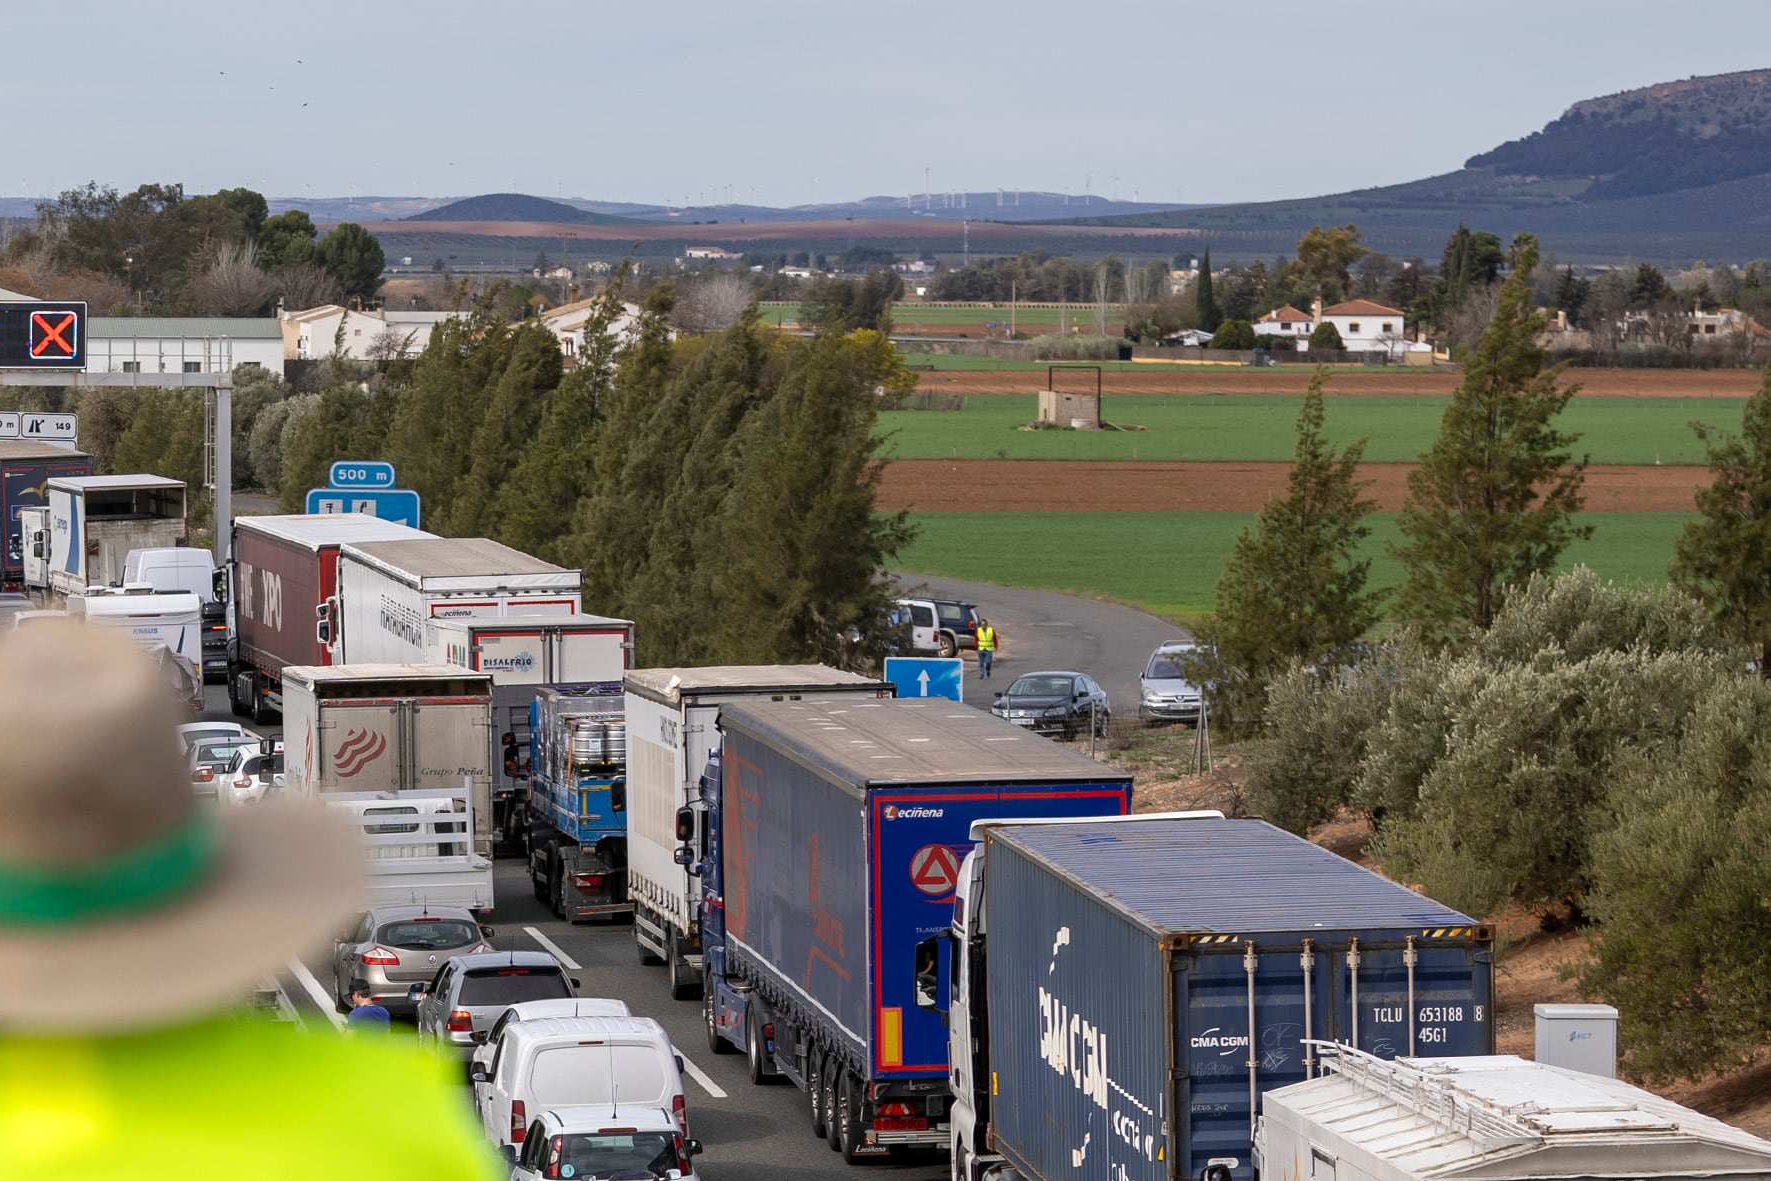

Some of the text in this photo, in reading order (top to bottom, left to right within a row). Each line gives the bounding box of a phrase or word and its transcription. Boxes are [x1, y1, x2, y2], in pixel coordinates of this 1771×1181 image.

[6, 421, 15, 429] m
[55, 422, 71, 431] 149
[338, 469, 388, 481] 500 m
[483, 658, 532, 667] DISALFRIO
[420, 766, 484, 776] Grupo Peña
[1373, 1007, 1483, 1023] TCLU 653188 8
[1418, 1027, 1447, 1043] 45G1
[1191, 1036, 1248, 1047] CMA CGM
